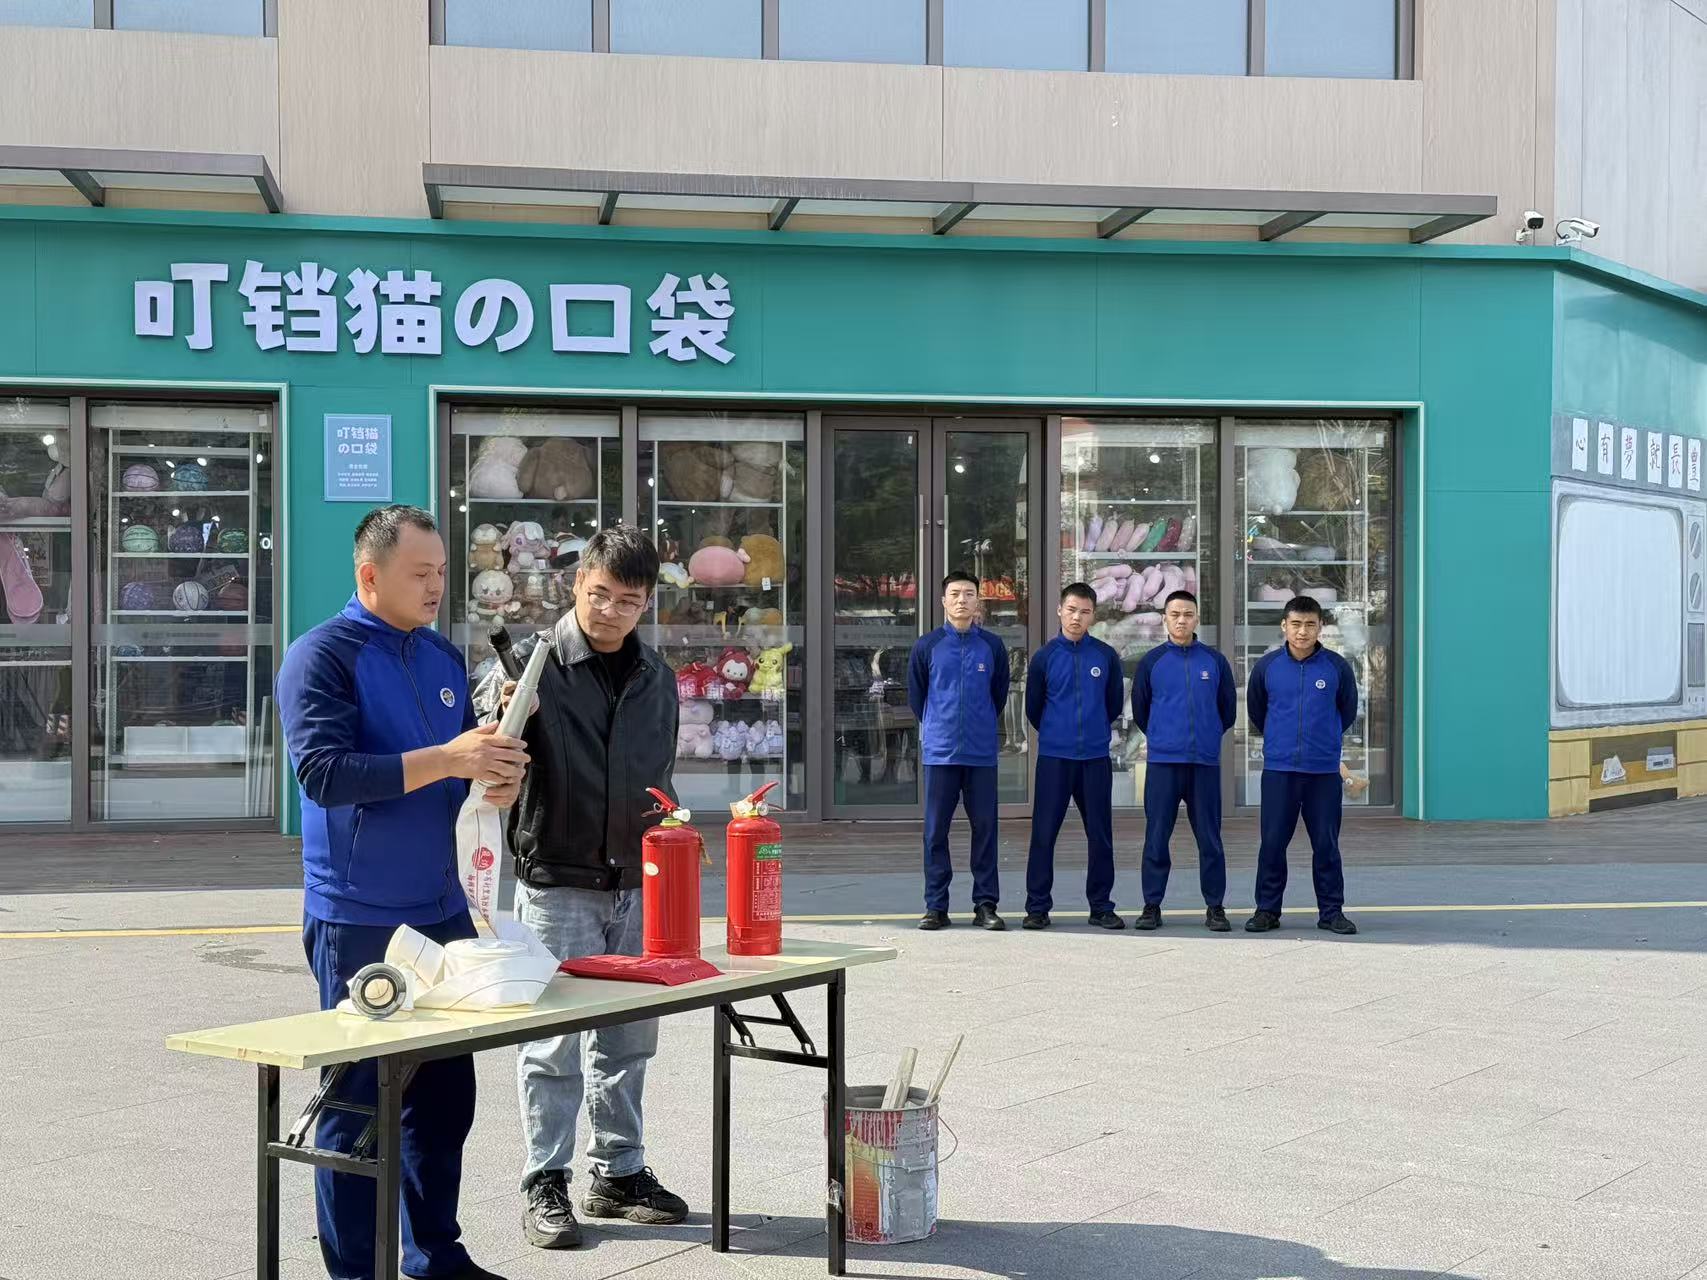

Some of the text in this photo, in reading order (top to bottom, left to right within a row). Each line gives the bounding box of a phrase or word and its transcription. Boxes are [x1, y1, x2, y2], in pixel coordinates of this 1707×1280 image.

[134, 259, 736, 365] 叮铛猫の口袋
[337, 426, 378, 440] 叮铛猫
[338, 442, 378, 455] の口袋
